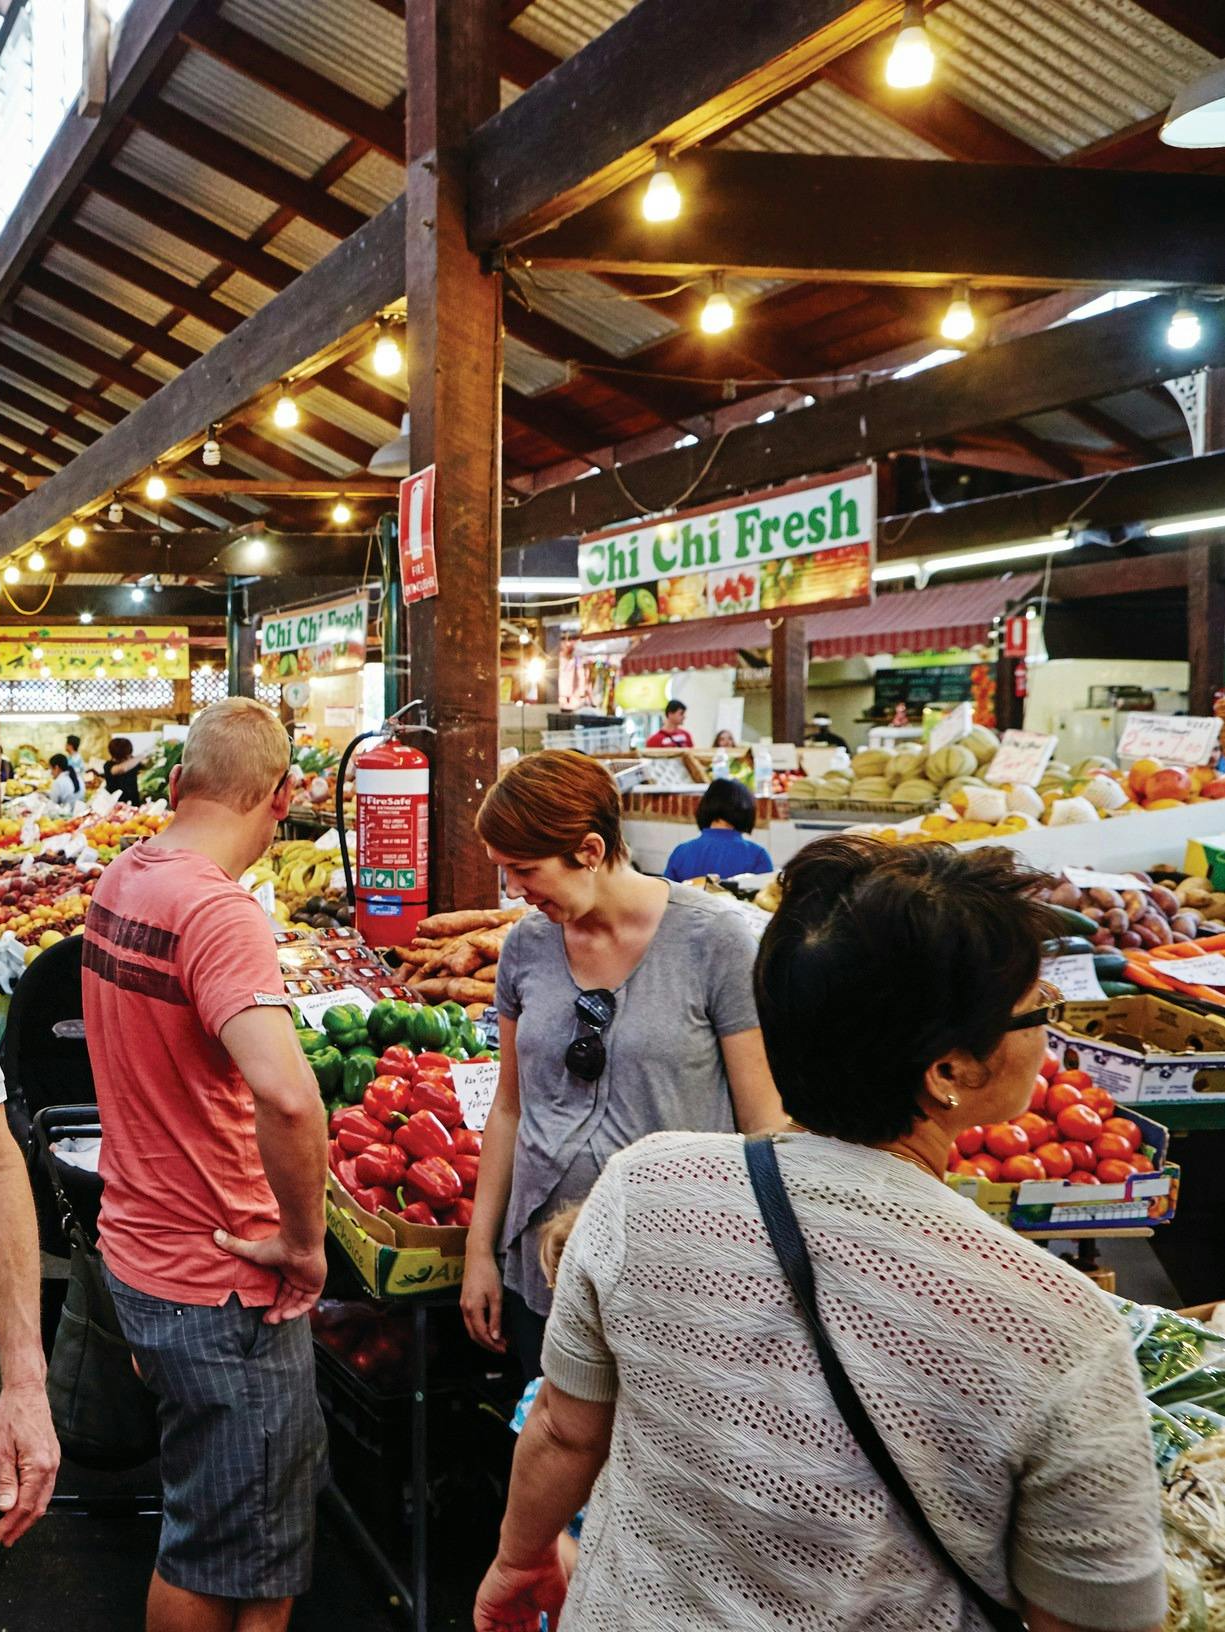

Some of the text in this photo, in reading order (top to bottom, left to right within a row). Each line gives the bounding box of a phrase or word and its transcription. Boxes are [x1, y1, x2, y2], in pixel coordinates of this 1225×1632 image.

[585, 488, 859, 586] Chi Chi Fresh
[411, 561, 425, 577] FIRE
[265, 620, 292, 650] Chi
[297, 614, 323, 645] Chi
[367, 795, 412, 806] FireSafe
